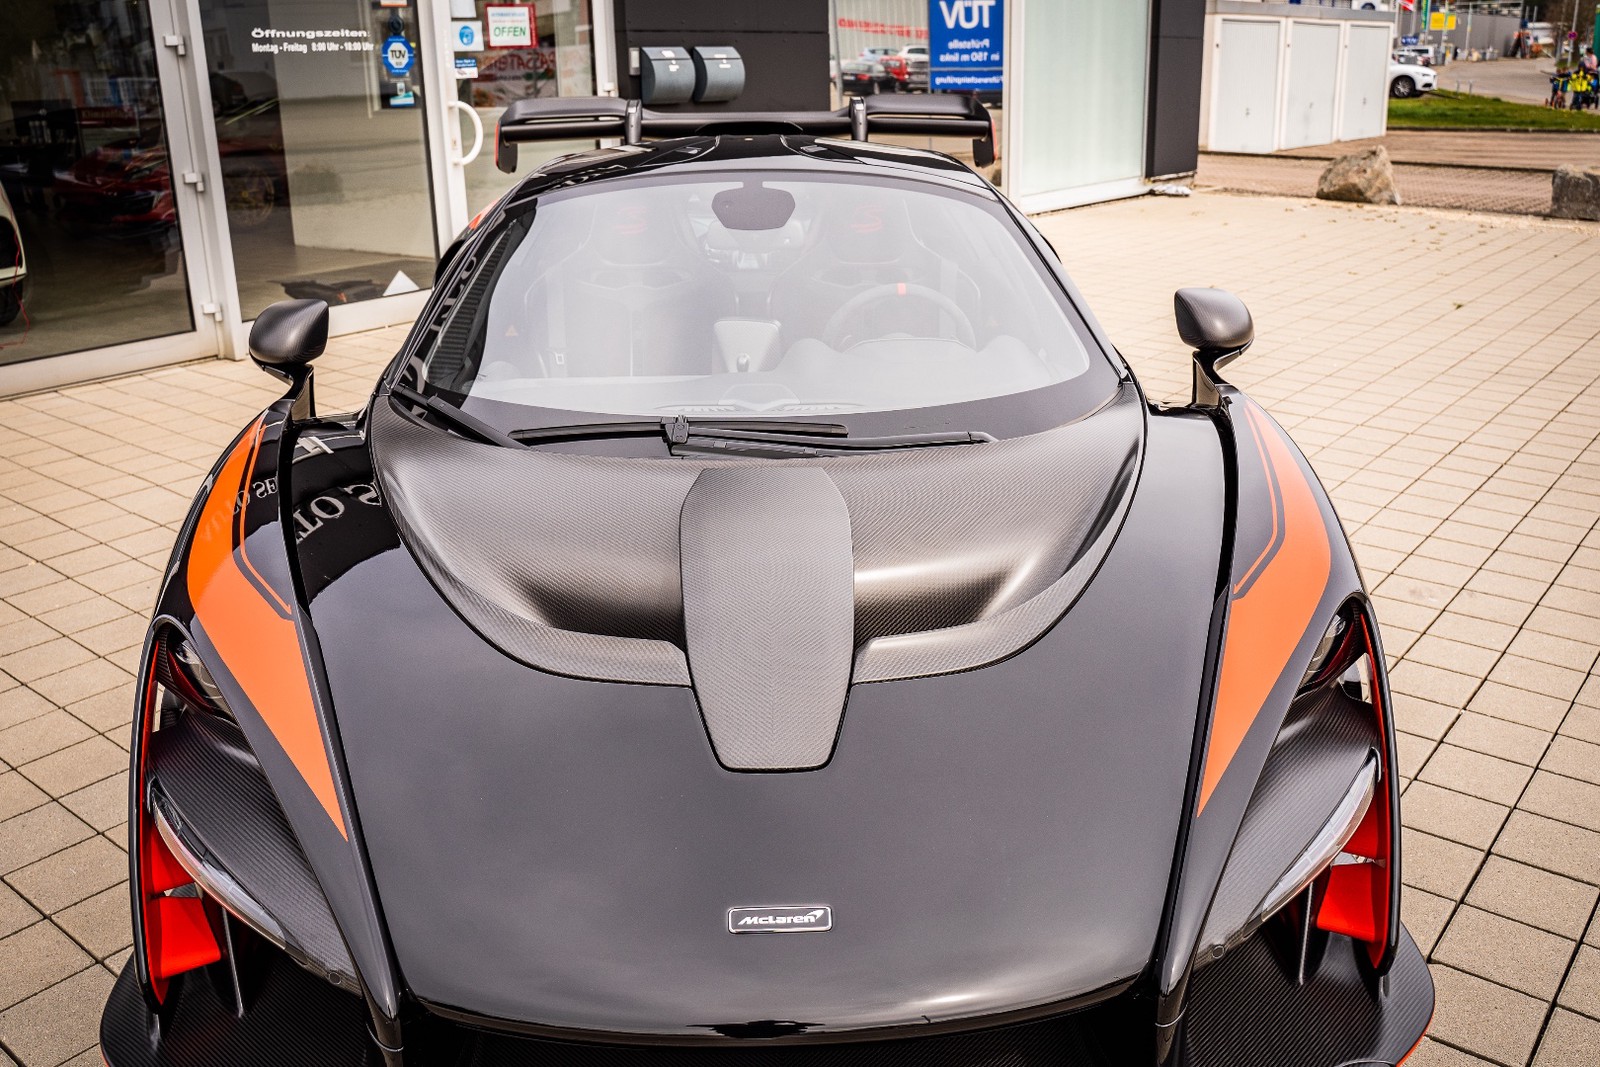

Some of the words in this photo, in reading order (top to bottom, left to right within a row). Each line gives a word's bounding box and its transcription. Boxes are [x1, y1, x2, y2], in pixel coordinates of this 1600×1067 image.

[251, 28, 371, 39] Öffnungszeiten:
[494, 26, 526, 37] OFFEN
[251, 42, 279, 54] Montag
[283, 42, 308, 54] Freitag
[327, 42, 339, 52] Uhr
[362, 42, 374, 52] Uhr
[738, 915, 816, 925] McLaren
